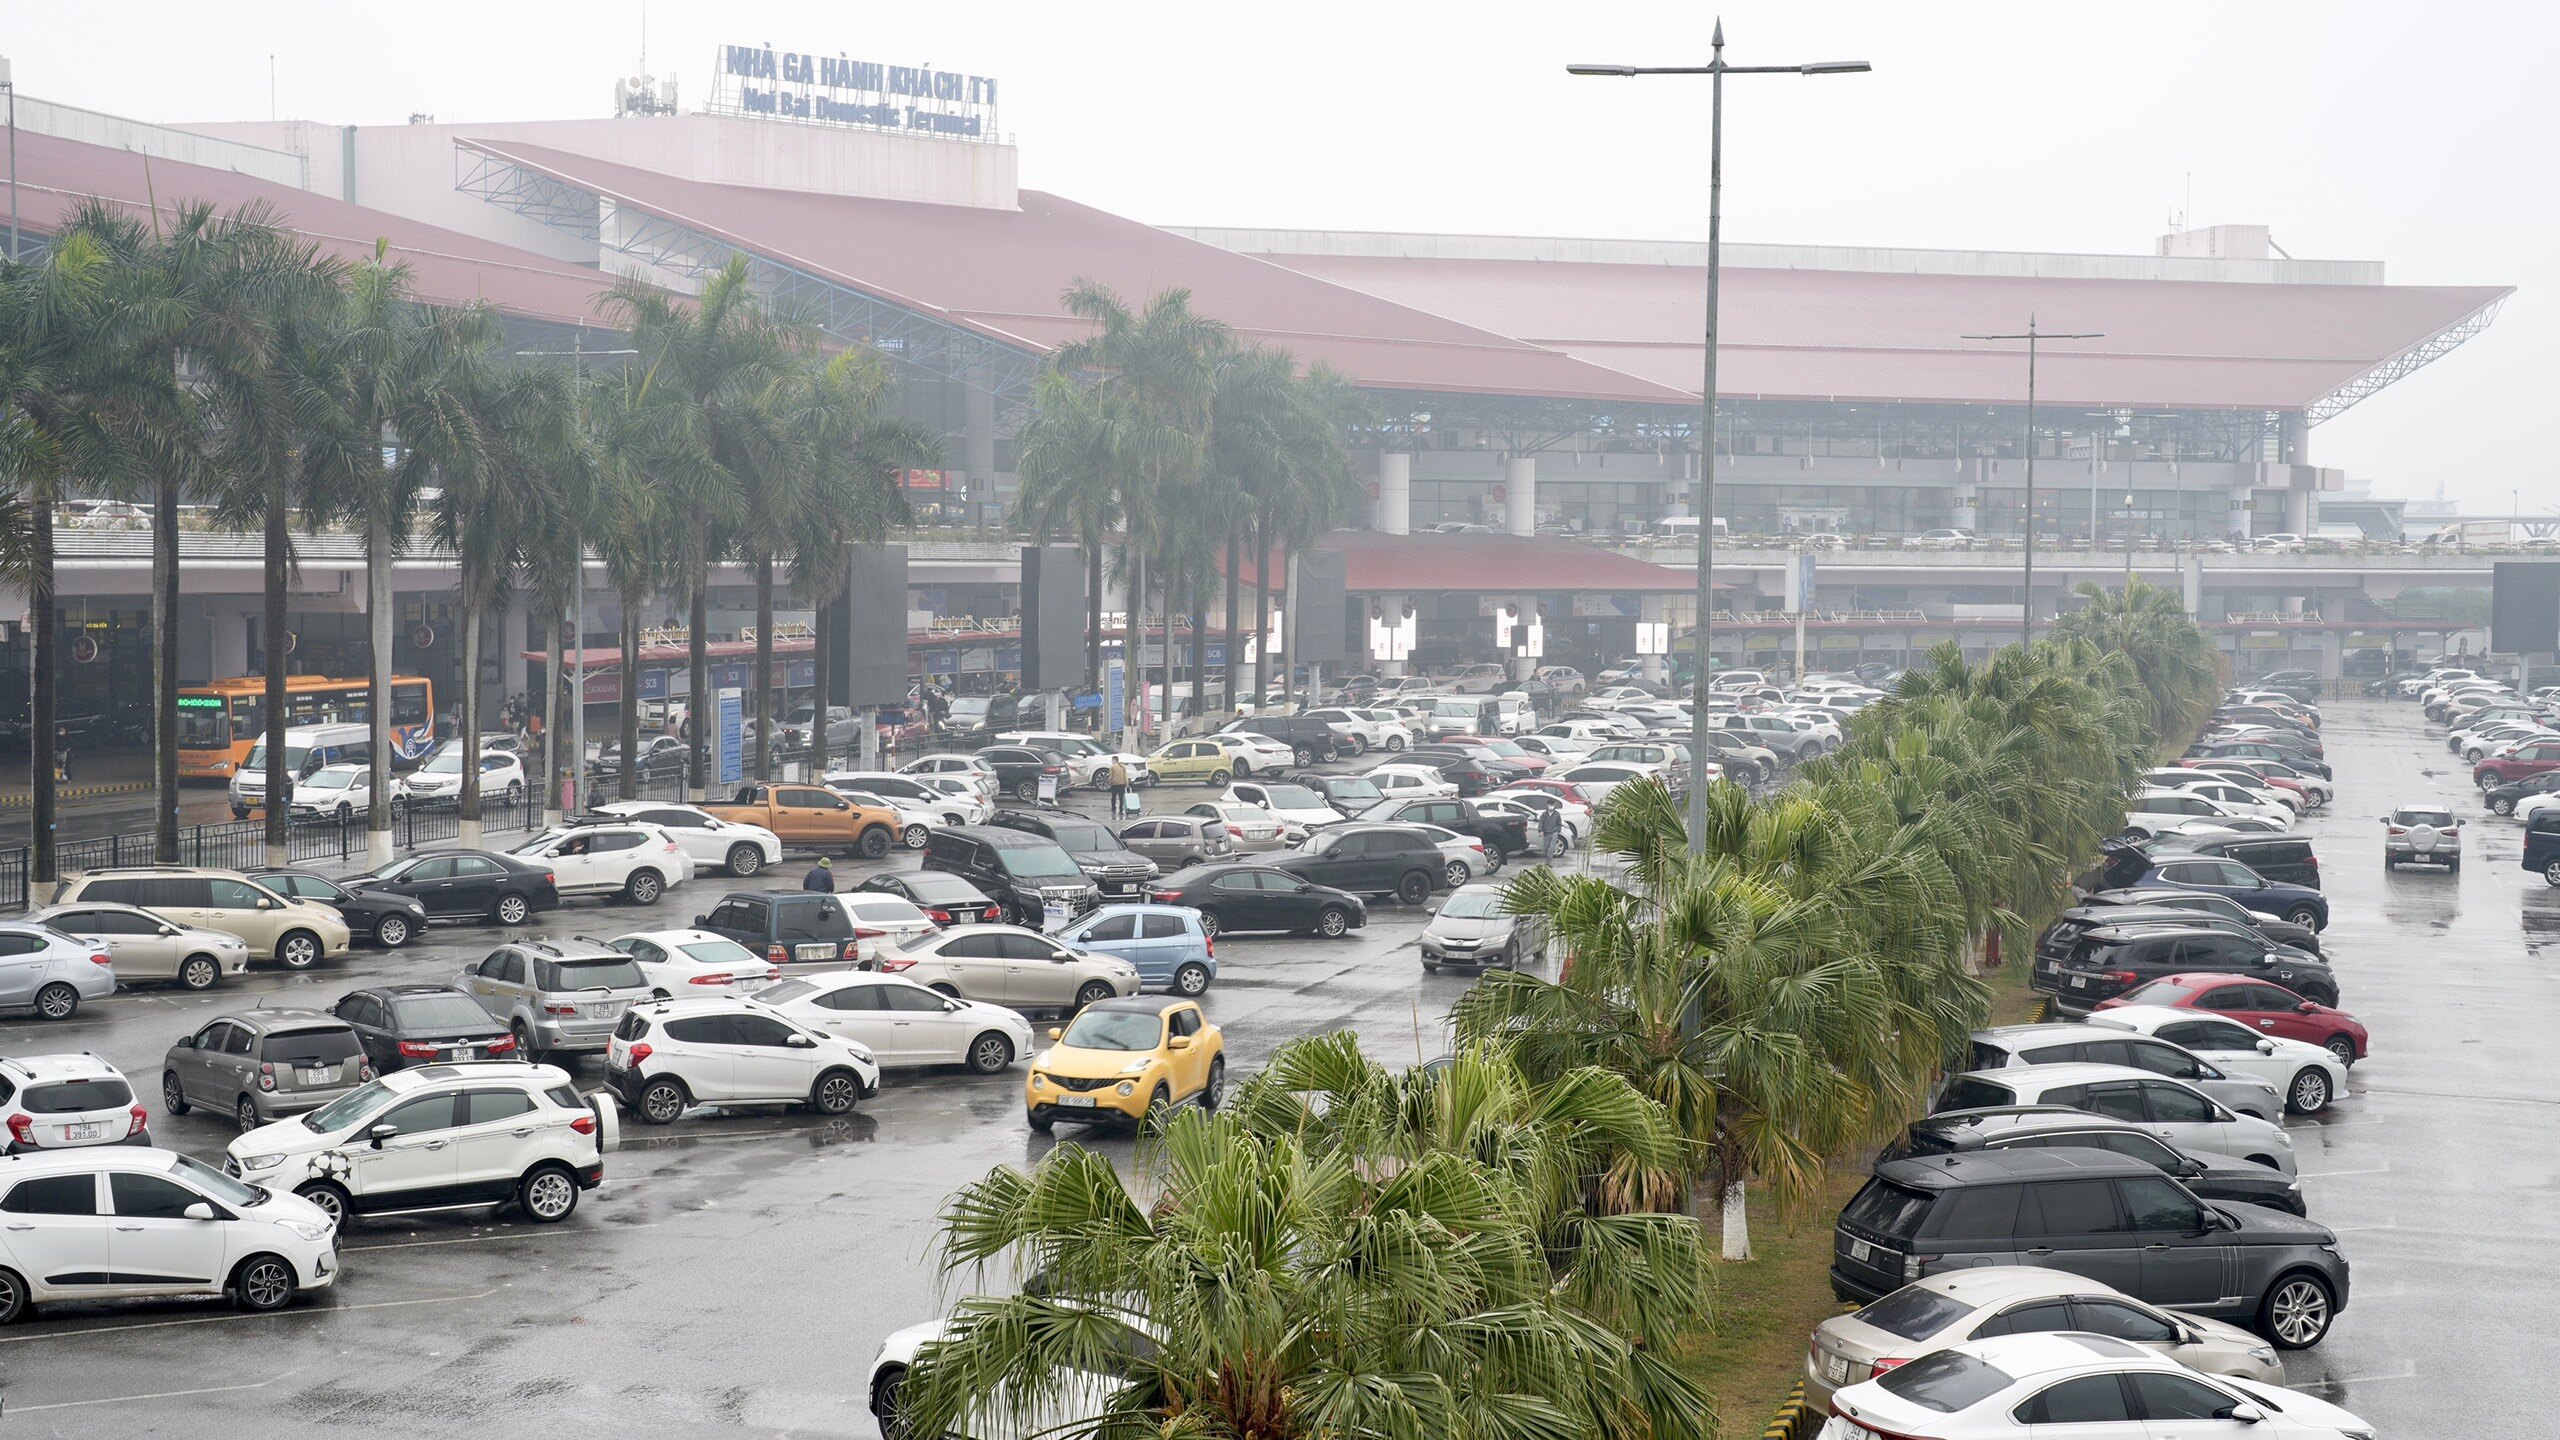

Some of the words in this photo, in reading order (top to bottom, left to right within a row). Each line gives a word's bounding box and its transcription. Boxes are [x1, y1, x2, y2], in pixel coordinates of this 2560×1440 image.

[727, 42, 777, 80] NHÀ
[783, 53, 814, 84] GA
[821, 51, 883, 93] HÀNH
[889, 62, 963, 101] KHÁCH
[969, 76, 995, 105] T1
[816, 96, 900, 127] Domestic
[905, 106, 981, 136] Terminal
[1107, 652, 1122, 660] SCB
[1207, 650, 1221, 658] SCB
[728, 671, 739, 681] SCB
[645, 678, 657, 689] SCB
[591, 684, 617, 693] AGRIBANK
[73, 1130, 97, 1139] 391.00
